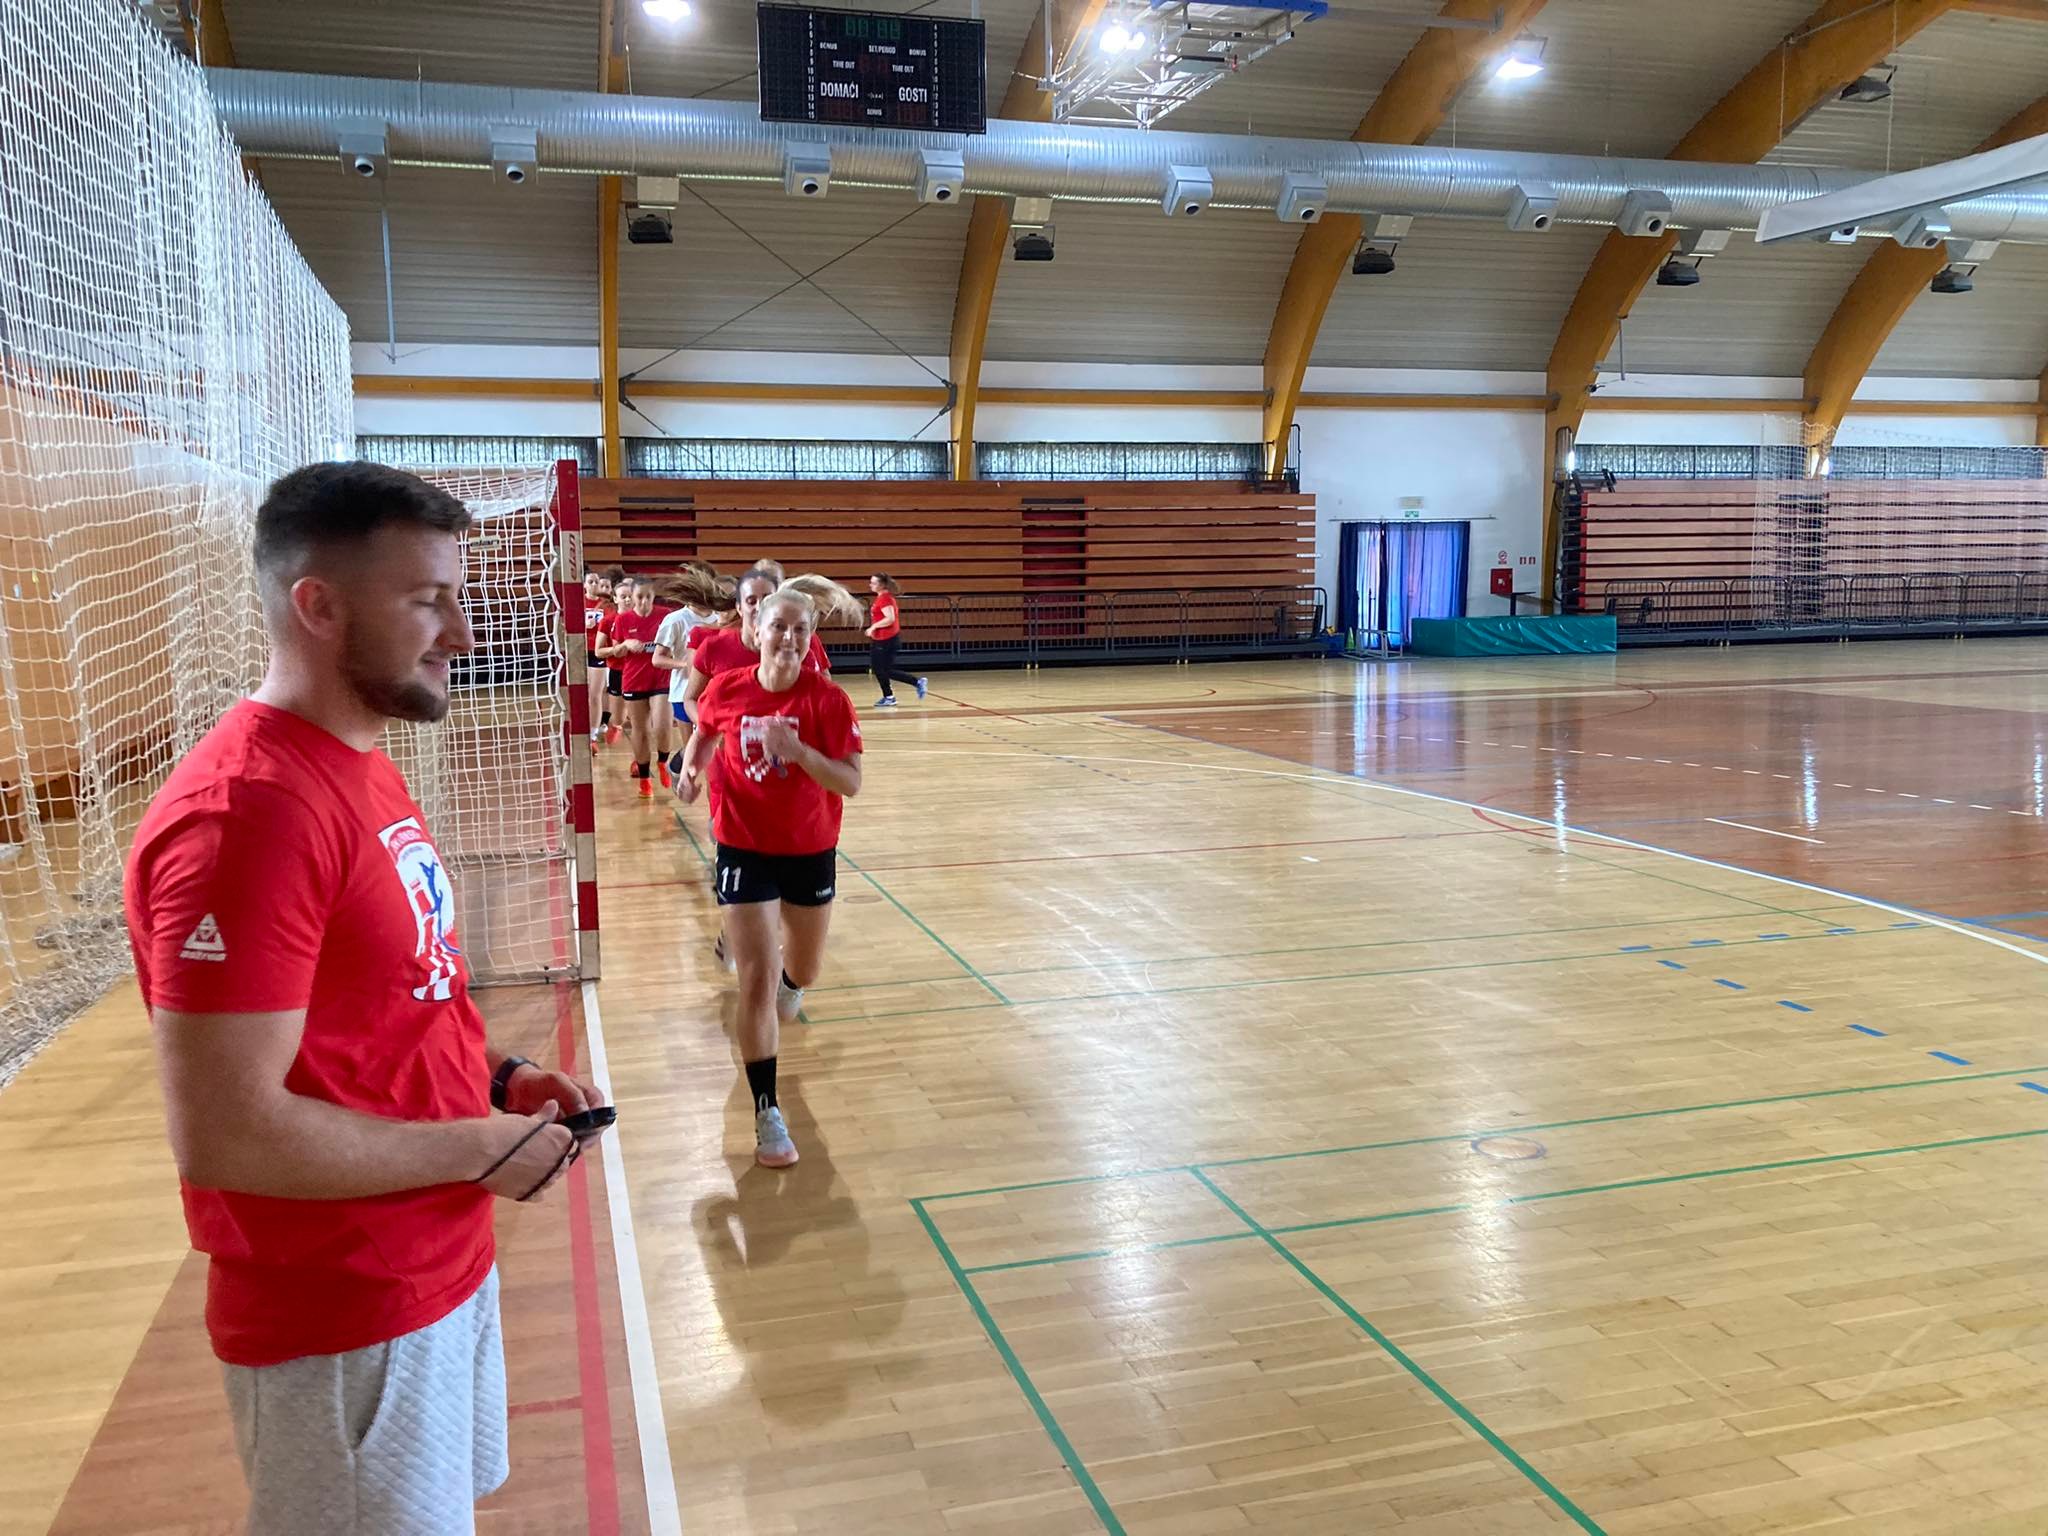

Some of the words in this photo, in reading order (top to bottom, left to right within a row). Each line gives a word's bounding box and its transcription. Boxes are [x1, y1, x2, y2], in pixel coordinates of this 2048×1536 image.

[820, 81, 859, 98] DOMAĆI
[898, 87, 928, 103] GOSTI
[721, 866, 741, 892] 11
